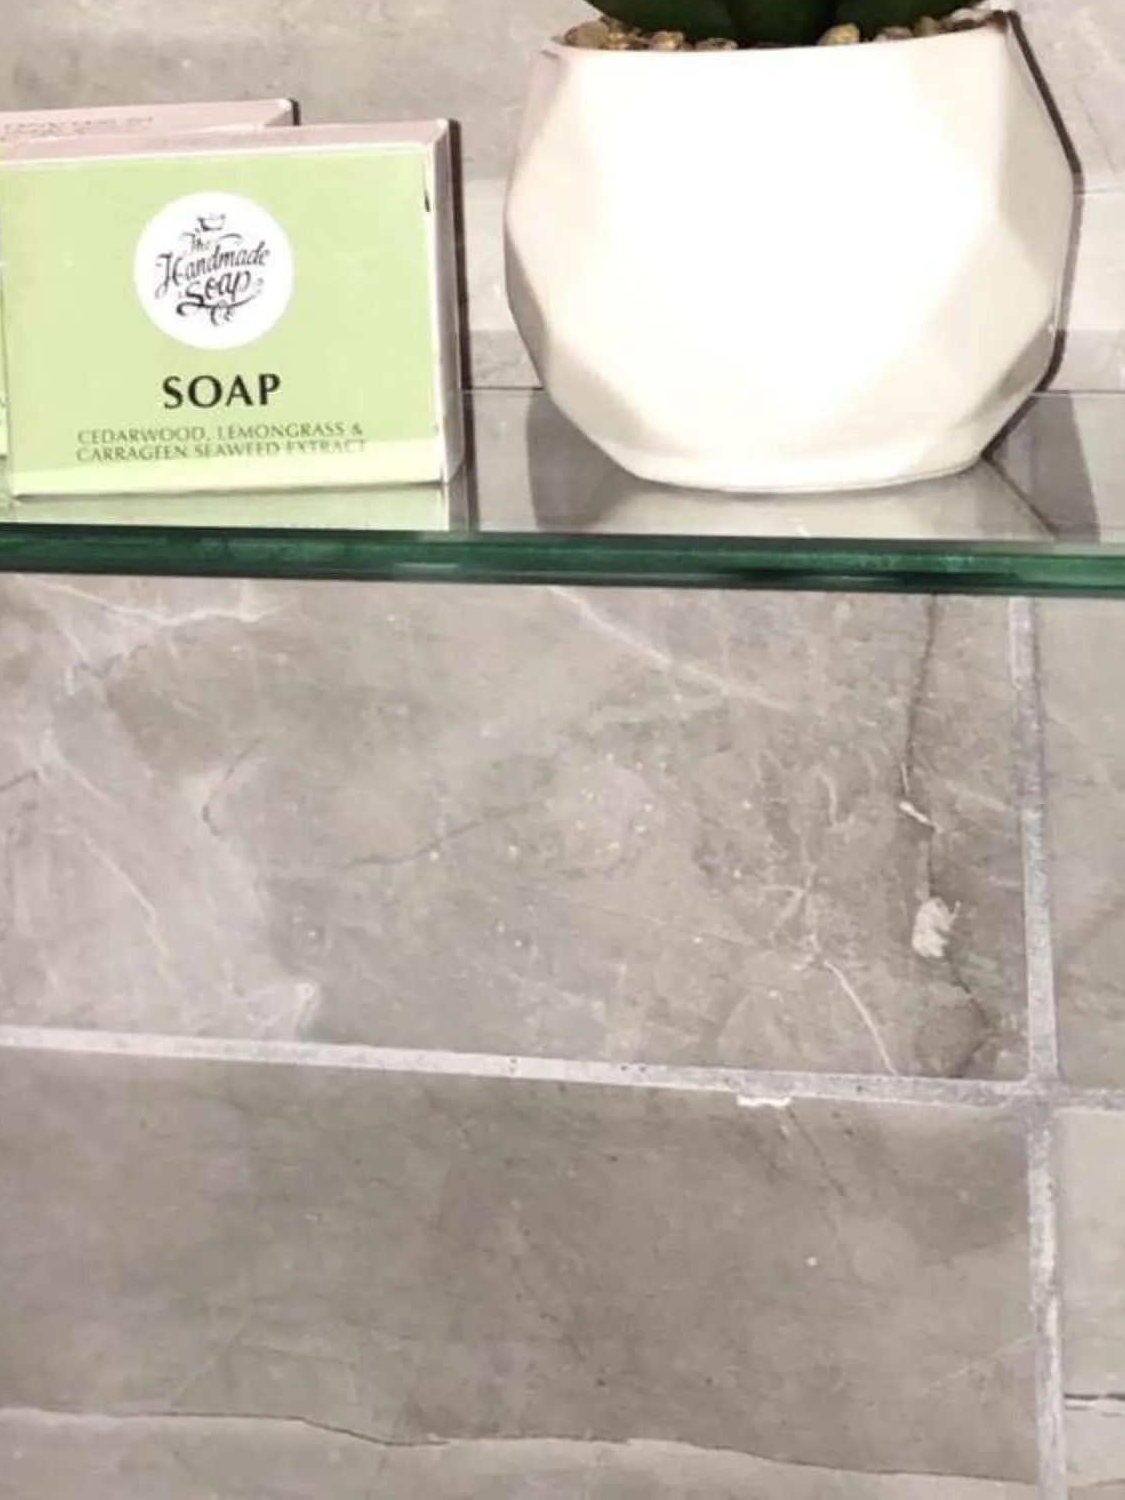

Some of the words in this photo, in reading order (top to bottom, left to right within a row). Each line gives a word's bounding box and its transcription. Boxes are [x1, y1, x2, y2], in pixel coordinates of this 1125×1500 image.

[154, 241, 271, 300] Handmade
[175, 270, 253, 318] Soap
[161, 372, 282, 410] SOAP
[77, 425, 211, 446] CEDARWOOD,
[217, 421, 346, 441] LEMONGRASS
[194, 441, 281, 459] SEAWEED
